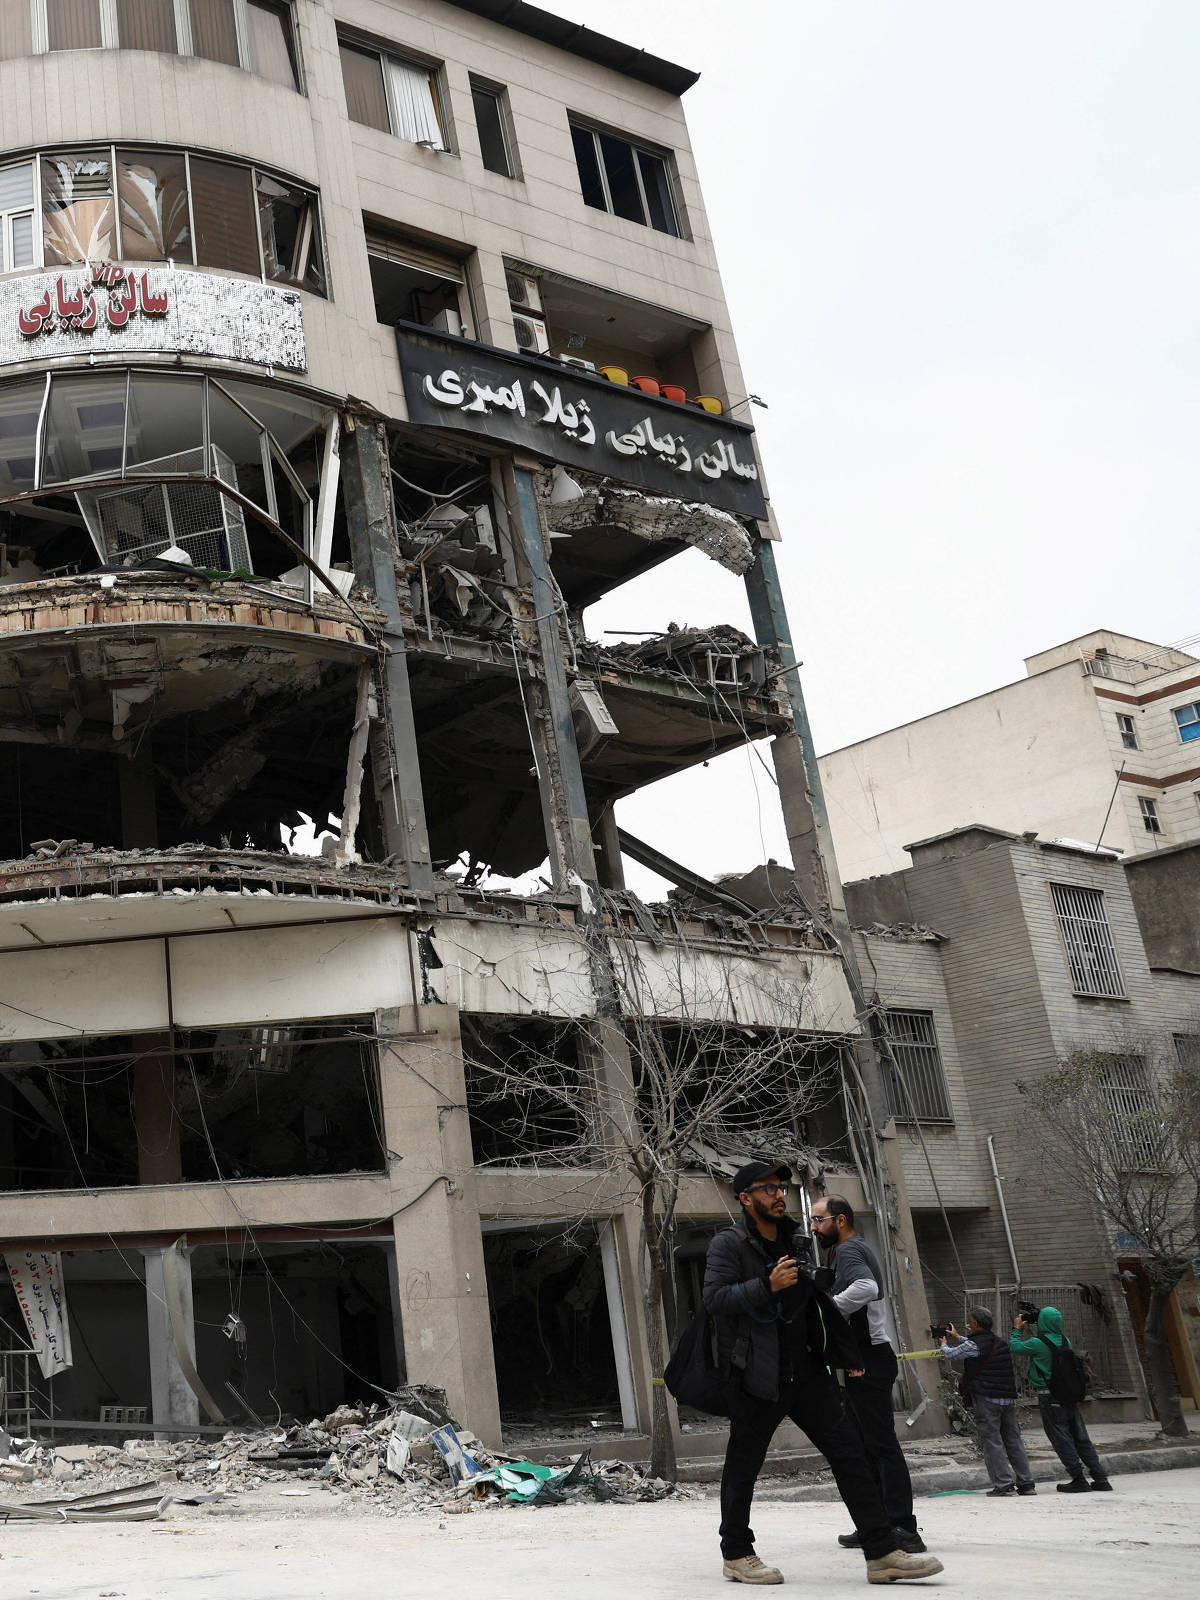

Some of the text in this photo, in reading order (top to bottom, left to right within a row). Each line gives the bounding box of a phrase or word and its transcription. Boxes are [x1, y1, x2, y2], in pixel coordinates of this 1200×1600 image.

[91, 263, 125, 285] vip
[18, 273, 169, 335] سالن زیبایی
[530, 380, 597, 445] ژیلا
[605, 416, 693, 472] زیبایی
[695, 438, 758, 481] سالن
